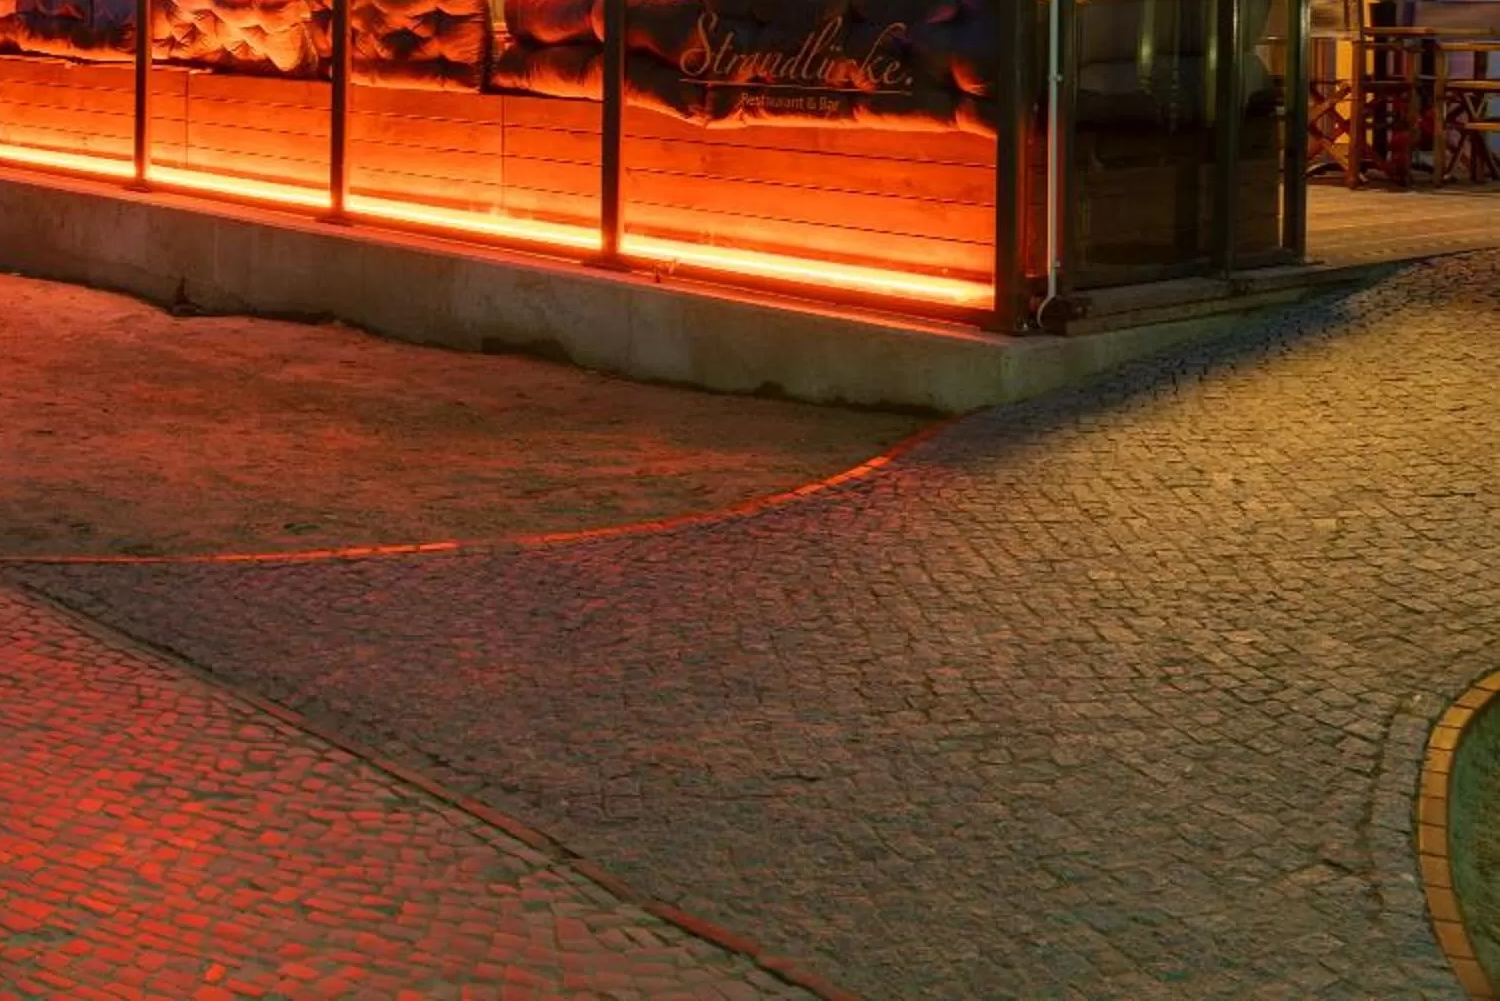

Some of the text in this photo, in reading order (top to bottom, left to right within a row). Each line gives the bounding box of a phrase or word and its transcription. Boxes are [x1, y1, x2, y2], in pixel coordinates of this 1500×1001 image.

[740, 92, 840, 112] Restaurant & Bar
